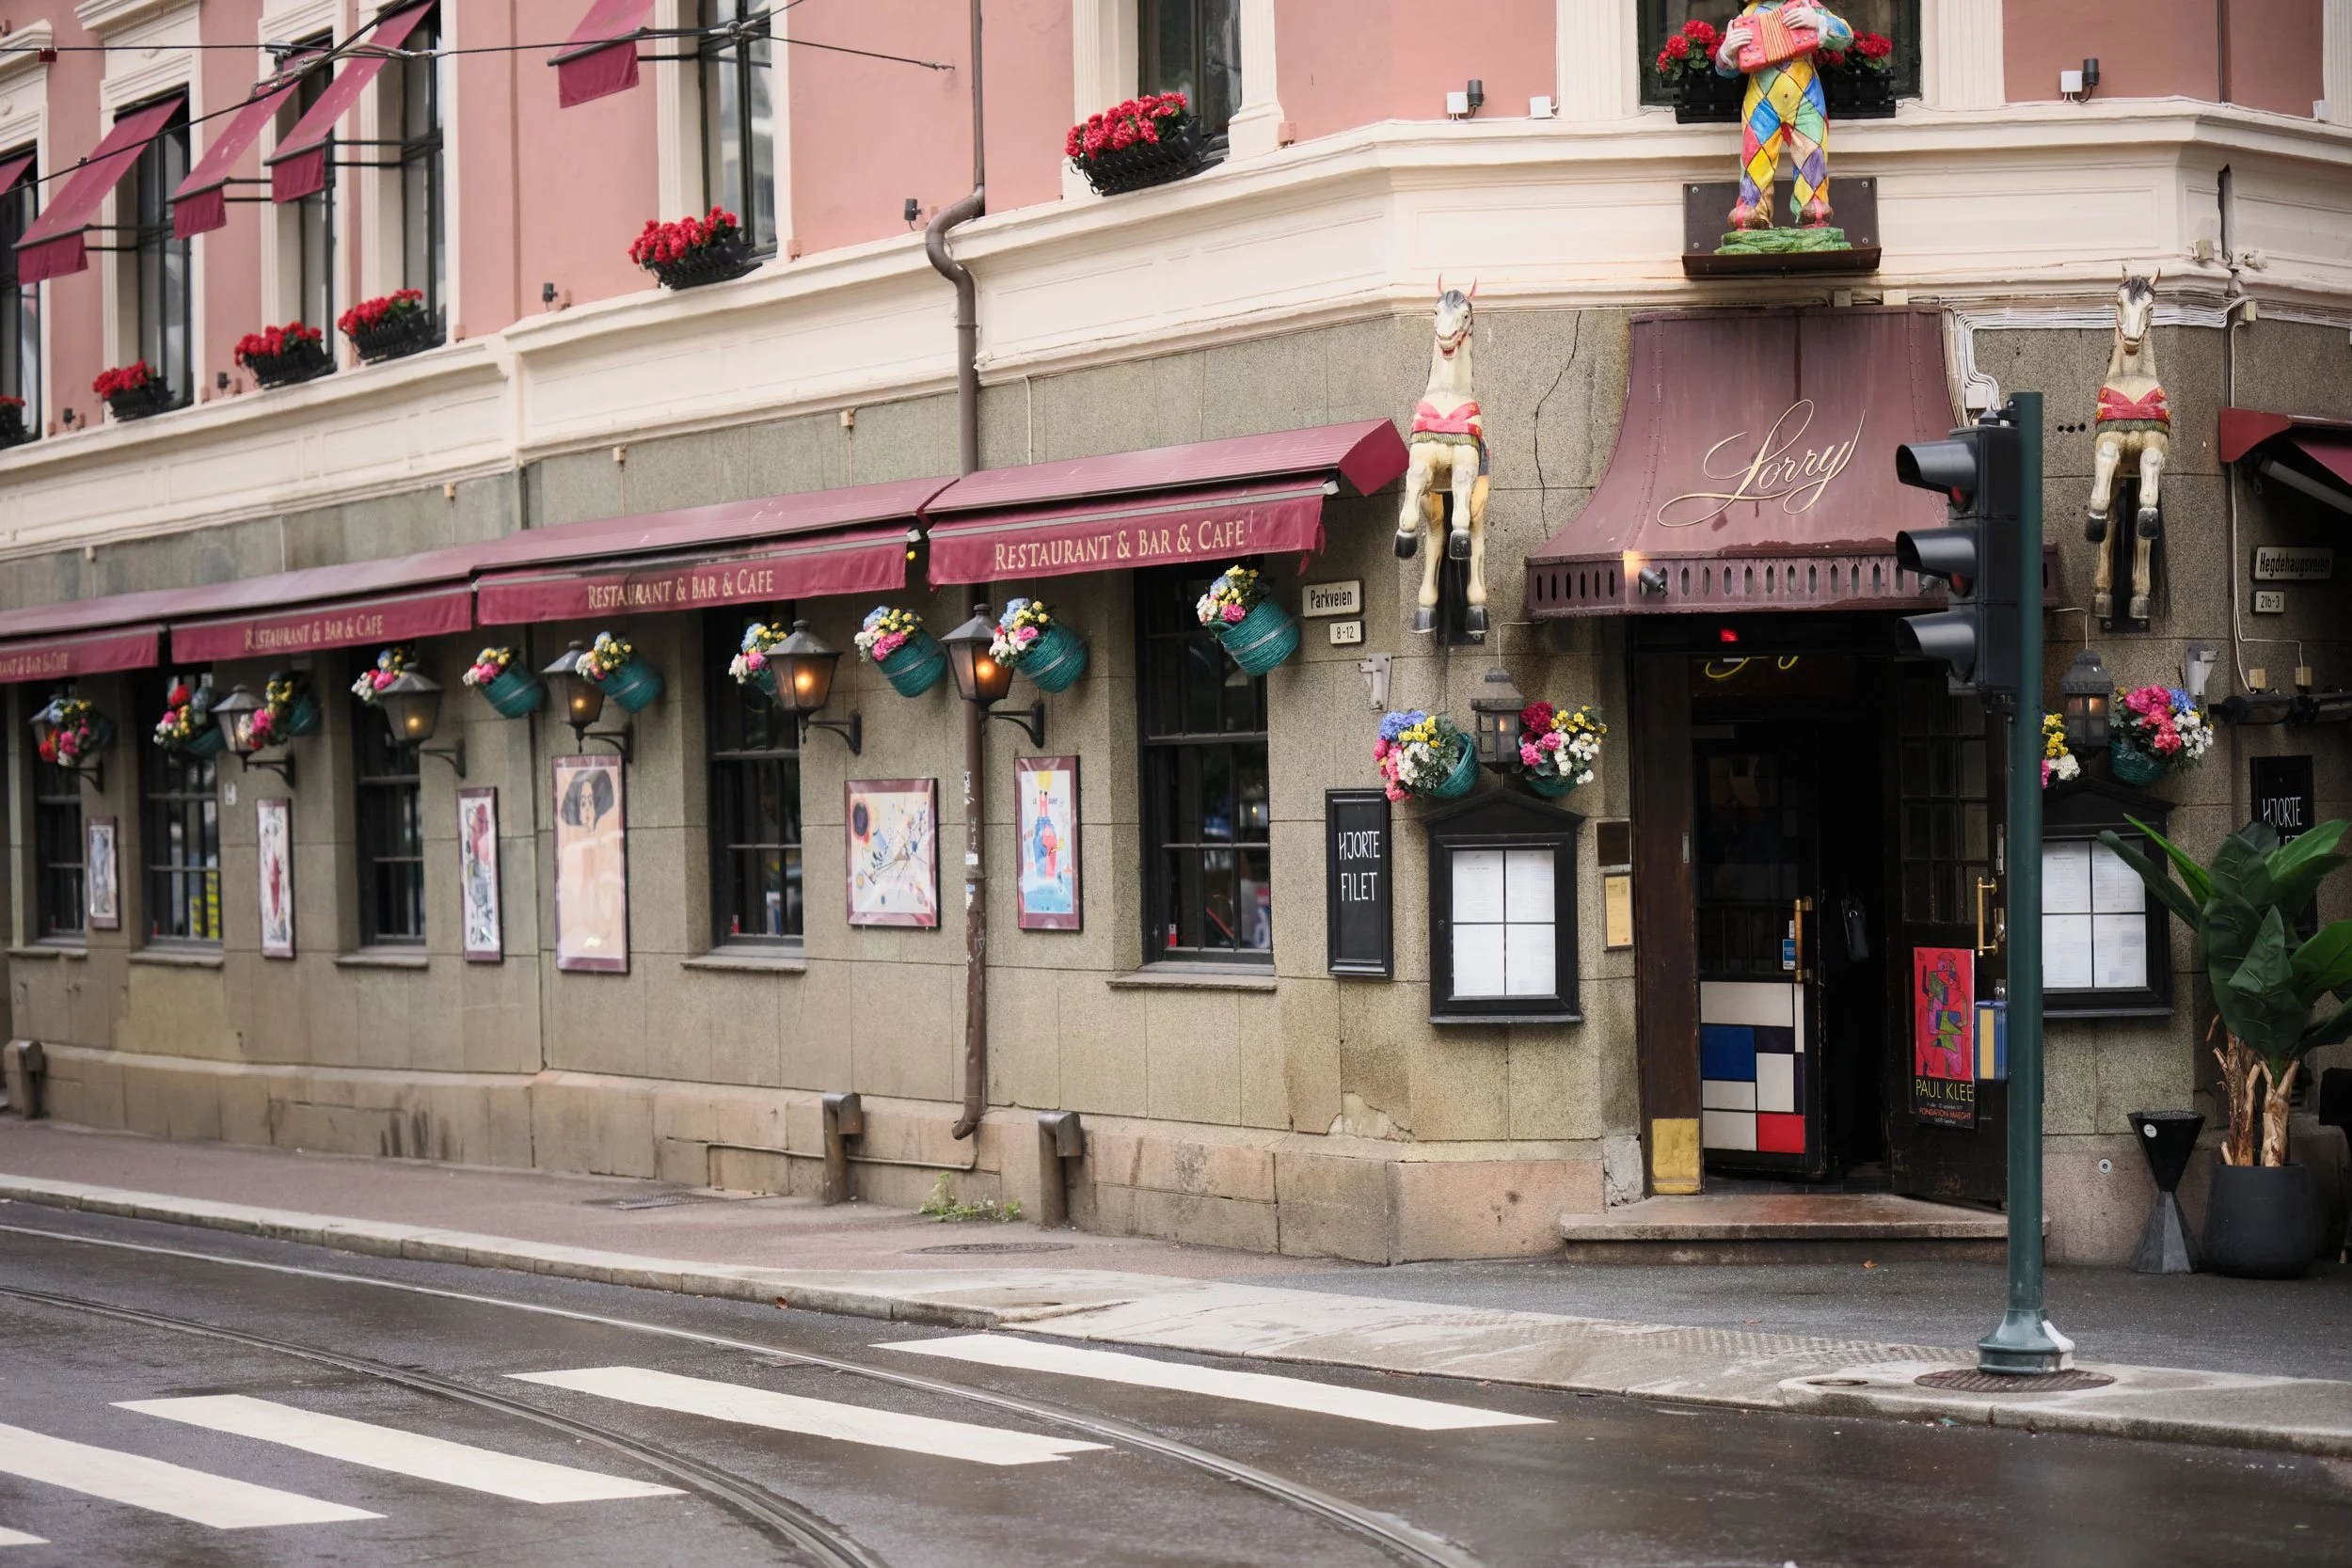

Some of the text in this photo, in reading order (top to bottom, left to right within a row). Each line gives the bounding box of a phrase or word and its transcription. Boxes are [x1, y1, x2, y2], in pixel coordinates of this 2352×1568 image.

[1657, 399, 1867, 528] Lorry
[994, 520, 1245, 572] RESTAURANT & BAR & CAFE
[2259, 552, 2330, 578] Hegdehaugsveien
[588, 568, 774, 610] RESTAURANT & BAR & CAFE
[1311, 587, 1352, 610] Parkveien
[245, 614, 383, 651] RSTAURANT & BAR & CAFE
[1336, 626, 1354, 640] 8-12
[2263, 797, 2302, 828] HJORTE
[1338, 831, 1381, 861] HJORTE
[1341, 872, 1378, 902] FILET
[1915, 1079, 1974, 1102] PAUL KLEE
